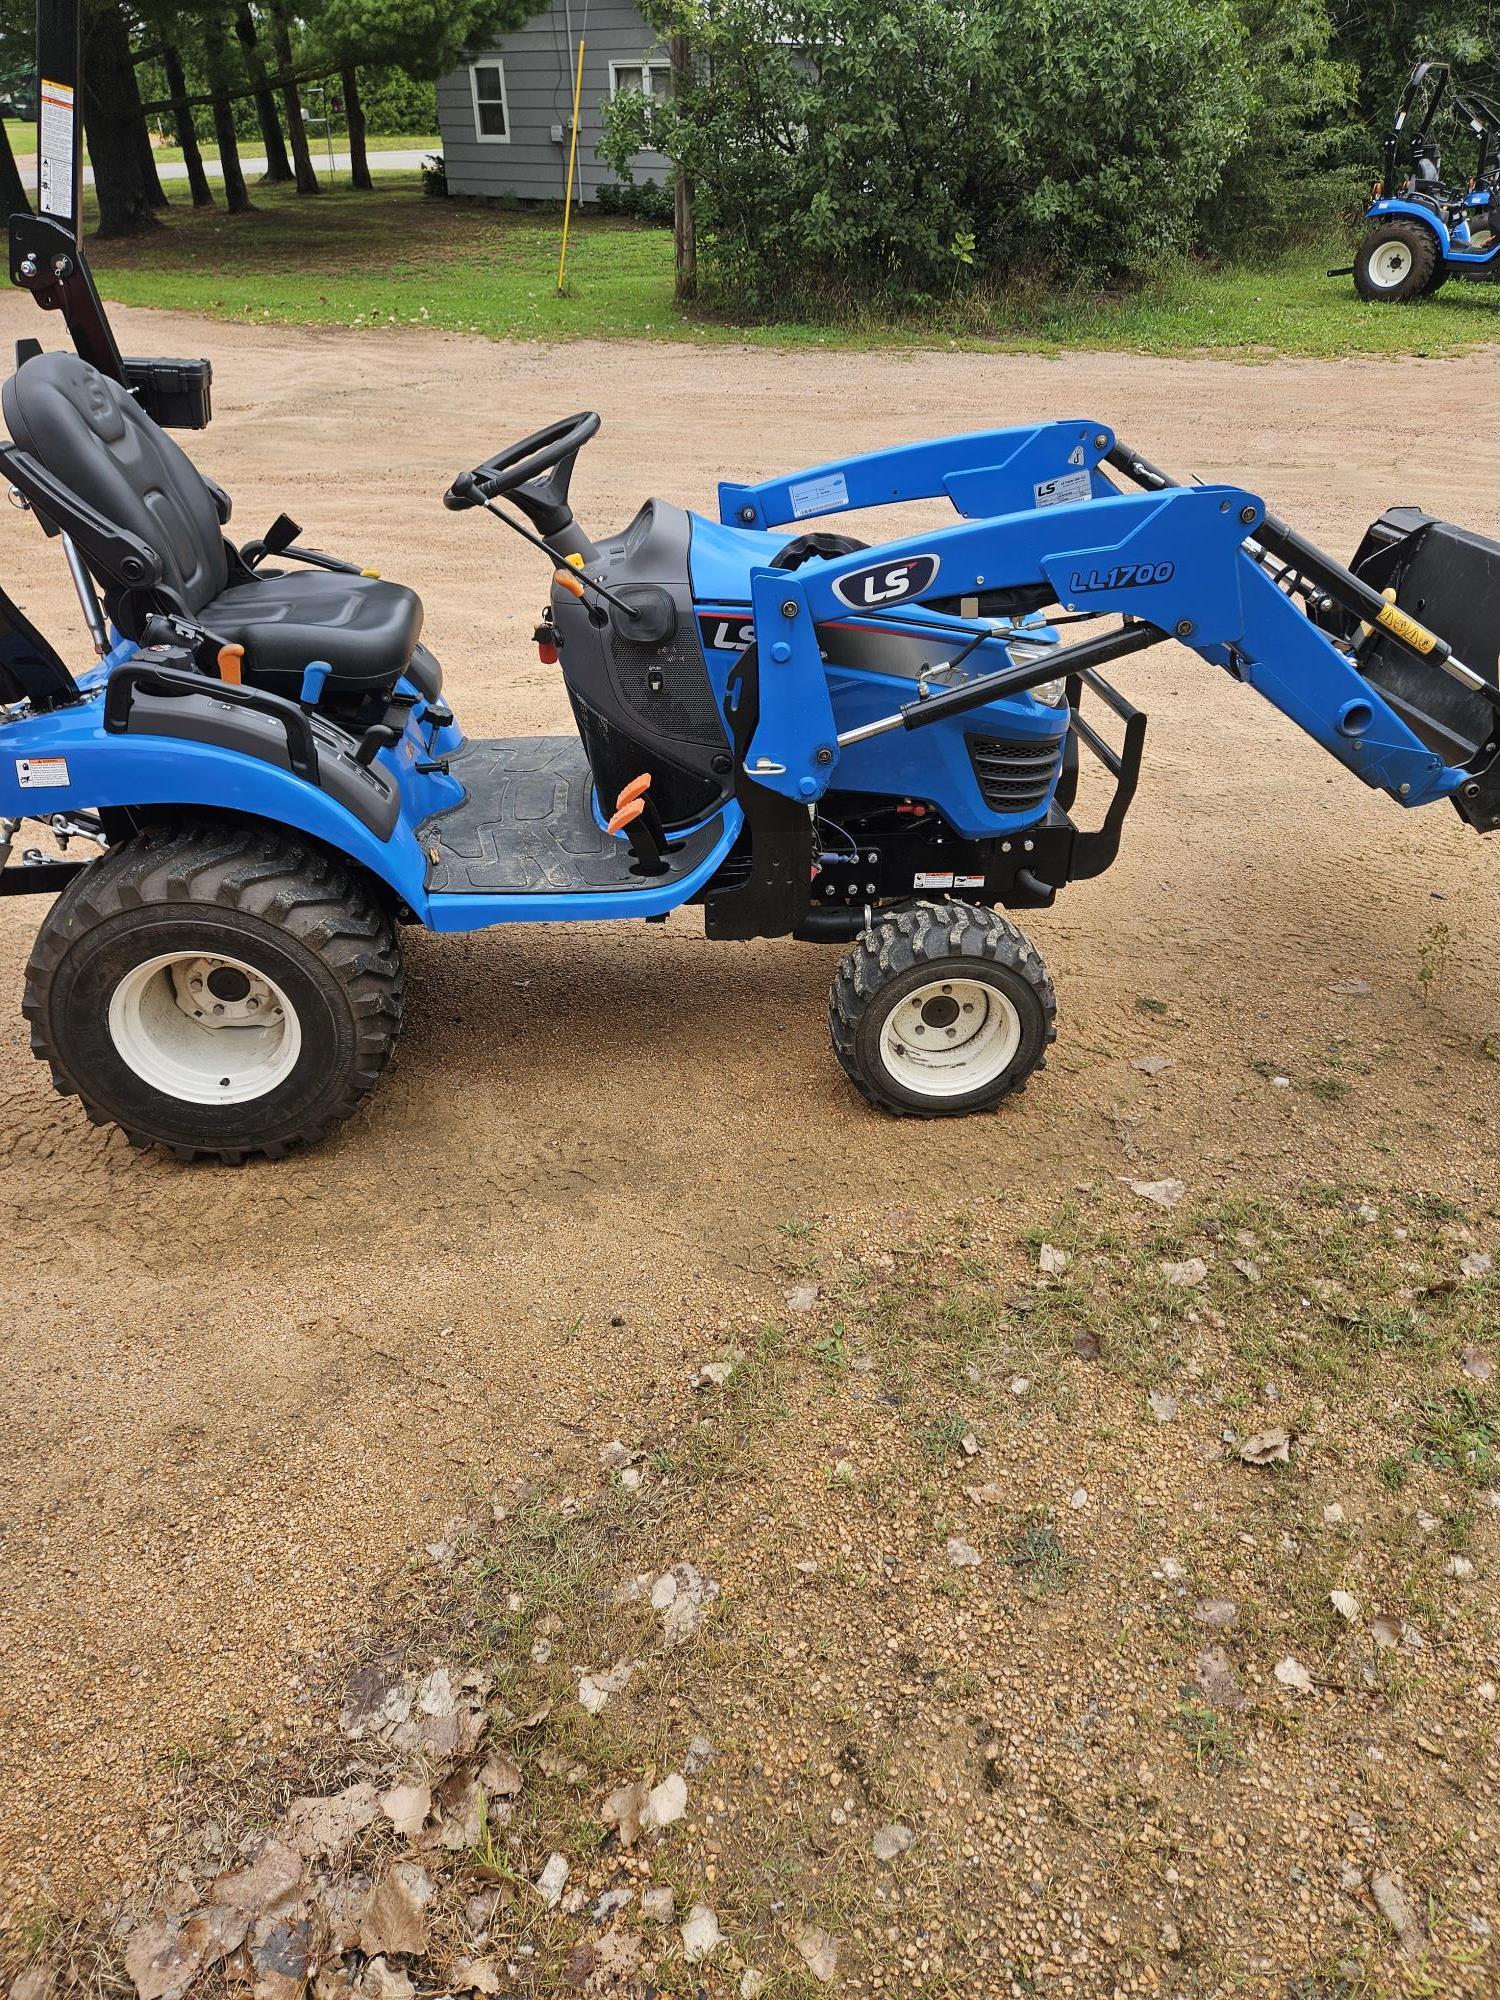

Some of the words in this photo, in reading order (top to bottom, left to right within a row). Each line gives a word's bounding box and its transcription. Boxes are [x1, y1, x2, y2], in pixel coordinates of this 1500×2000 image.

[1038, 483, 1056, 497] LS
[864, 567, 911, 603] LS
[1069, 561, 1175, 593] LL1700
